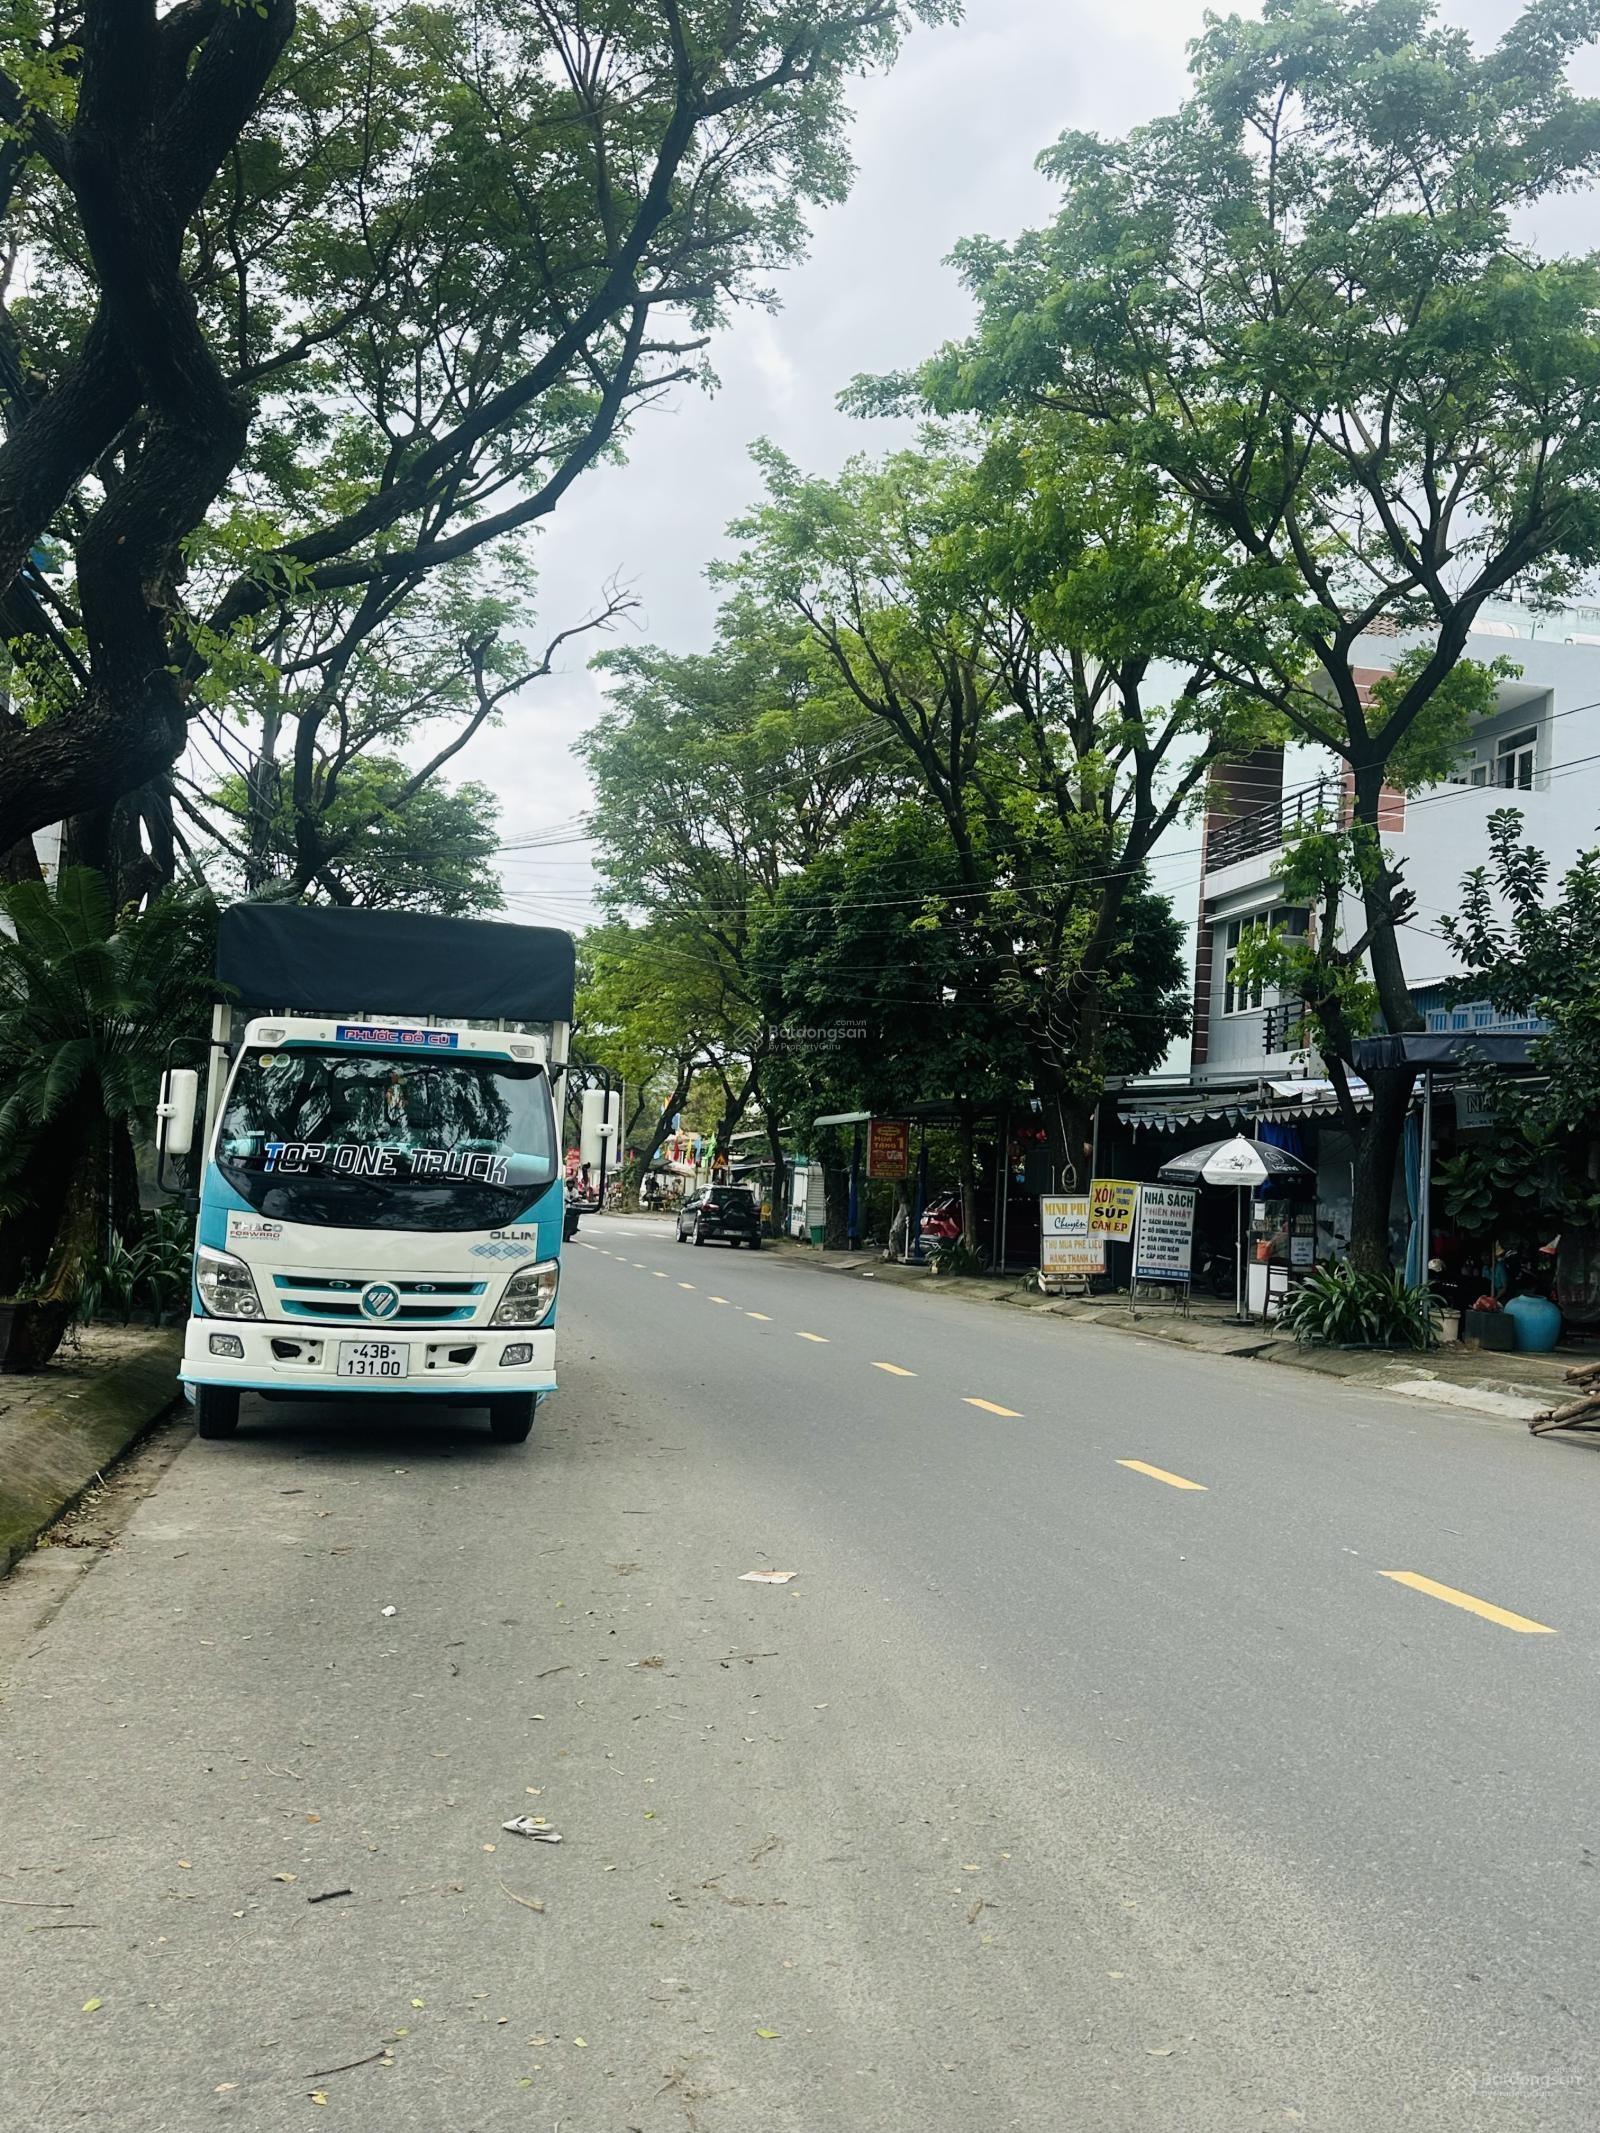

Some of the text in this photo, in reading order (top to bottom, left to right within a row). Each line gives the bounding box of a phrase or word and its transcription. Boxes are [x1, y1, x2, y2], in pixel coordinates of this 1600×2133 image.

[264, 1143, 509, 1184] TOP ONE TRUCK
[1144, 1190, 1164, 1206] NHÀ
[1167, 1192, 1194, 1208] SÁCH
[1044, 1203, 1068, 1215] MINH
[1094, 1205, 1129, 1219] SÚP
[232, 1221, 283, 1232] THACO
[230, 1230, 280, 1238] FORWARD
[490, 1231, 537, 1241] OLLIN
[359, 1344, 390, 1359] 43B
[348, 1360, 401, 1376] 131.00
